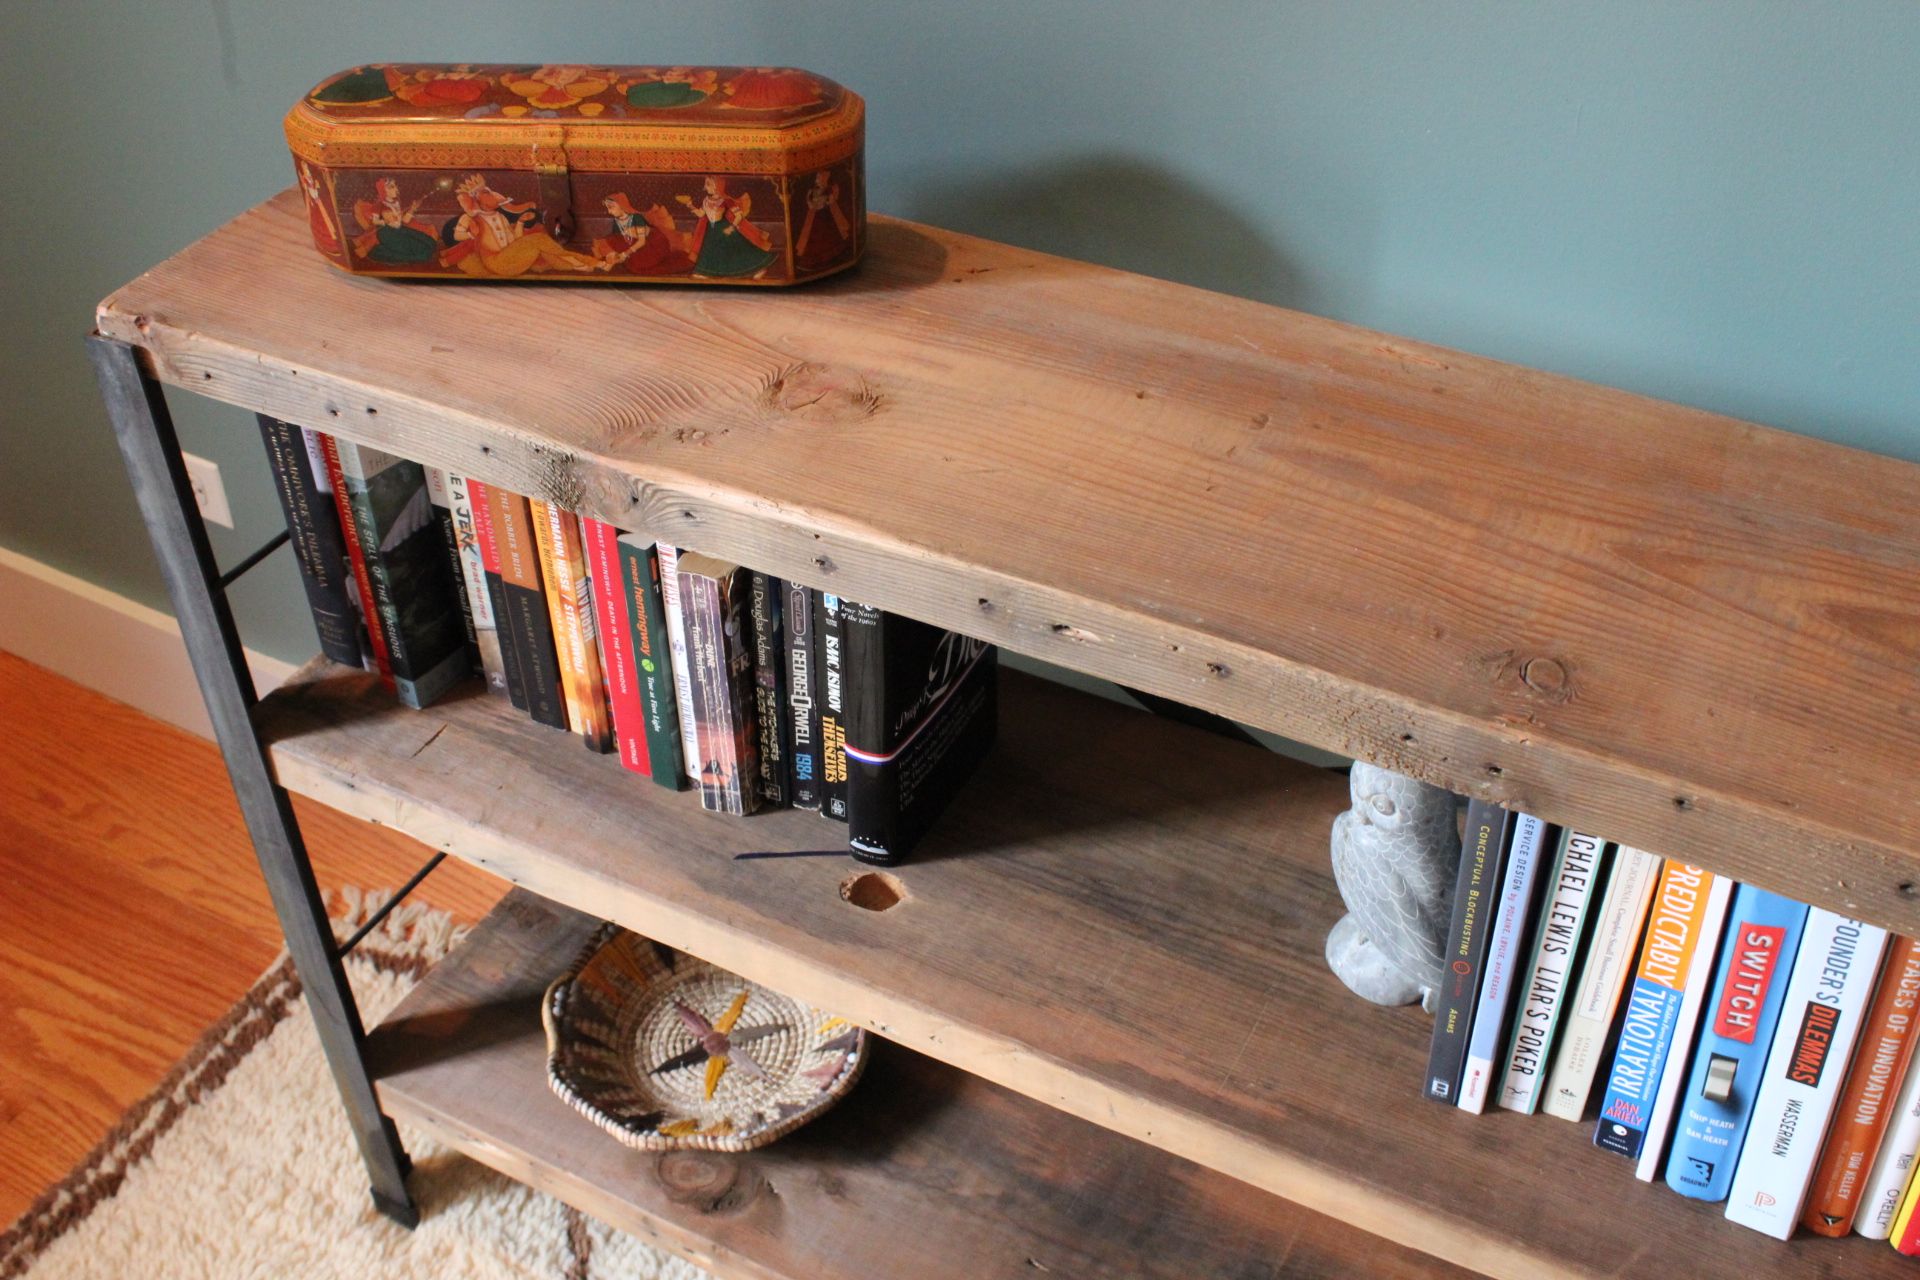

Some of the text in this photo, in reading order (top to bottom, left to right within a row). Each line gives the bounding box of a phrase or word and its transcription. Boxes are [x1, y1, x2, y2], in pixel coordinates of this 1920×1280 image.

[305, 428, 319, 460] BLIC
[326, 434, 340, 464] onal
[333, 467, 360, 547] Exuberance
[432, 467, 443, 493] son
[453, 489, 465, 501] A
[456, 508, 479, 557] JERK
[477, 484, 501, 571] HE HANDMAID'S
[499, 491, 524, 578] THE ROBBER BRIDE
[547, 501, 566, 558] HERMANN
[306, 531, 329, 588] DILEMMA
[556, 558, 571, 592] HESSE
[600, 550, 613, 597] HEMINGWAY
[358, 505, 403, 660] THE SPELL OF THE SENSUOUS
[470, 560, 488, 620] brad warner
[607, 600, 618, 625] DEATH
[629, 555, 652, 657] ernest hemingway
[751, 589, 769, 633] Douglas
[857, 608, 881, 621] Novels
[563, 603, 586, 675] STEPPENWOLF
[611, 626, 619, 635] IN
[613, 637, 621, 650] THE
[756, 632, 772, 667] Adams
[825, 633, 841, 671] ISAAC
[616, 651, 628, 694] AFTERNOON
[791, 649, 809, 697] GEORGE
[826, 667, 842, 714] ASIMOV
[646, 676, 656, 691] True
[651, 715, 663, 733] Light
[756, 687, 767, 716] GUIDE
[766, 690, 777, 706] THE
[791, 694, 813, 747] ORWELL
[759, 718, 768, 729] TO
[760, 729, 769, 744] THE
[795, 752, 814, 781] 1984
[821, 714, 839, 784] THEMSELVES
[1470, 825, 1491, 886] CONCEPTUAL
[1519, 817, 1537, 857] SERVICE
[1511, 858, 1528, 892] DESIGN
[1557, 830, 1598, 894] ICHAEL
[1459, 888, 1480, 956] BLOCKBUSTING
[1543, 900, 1580, 956] LEWIS
[1525, 965, 1562, 1022] LIAR'S
[1725, 931, 1774, 1028] SWITCH
[1445, 1006, 1459, 1035] ADAMS
[1609, 986, 1667, 1100] IRRATIONAL
[1886, 1013, 1909, 1034] OF
[1510, 1023, 1546, 1078] POKER
[1791, 1004, 1837, 1086] DILEMMAS
[1854, 1037, 1901, 1126] INNOVATION
[1605, 1106, 1644, 1127] ARIELY
[1613, 1098, 1641, 1114] DAN
[1689, 1109, 1735, 1130] CHIP HEATH
[1771, 1098, 1804, 1158] WASSERMAN
[1685, 1126, 1729, 1147] DAN HEATH
[1848, 1151, 1865, 1172] TOM
[1837, 1171, 1859, 1201] KELLEY
